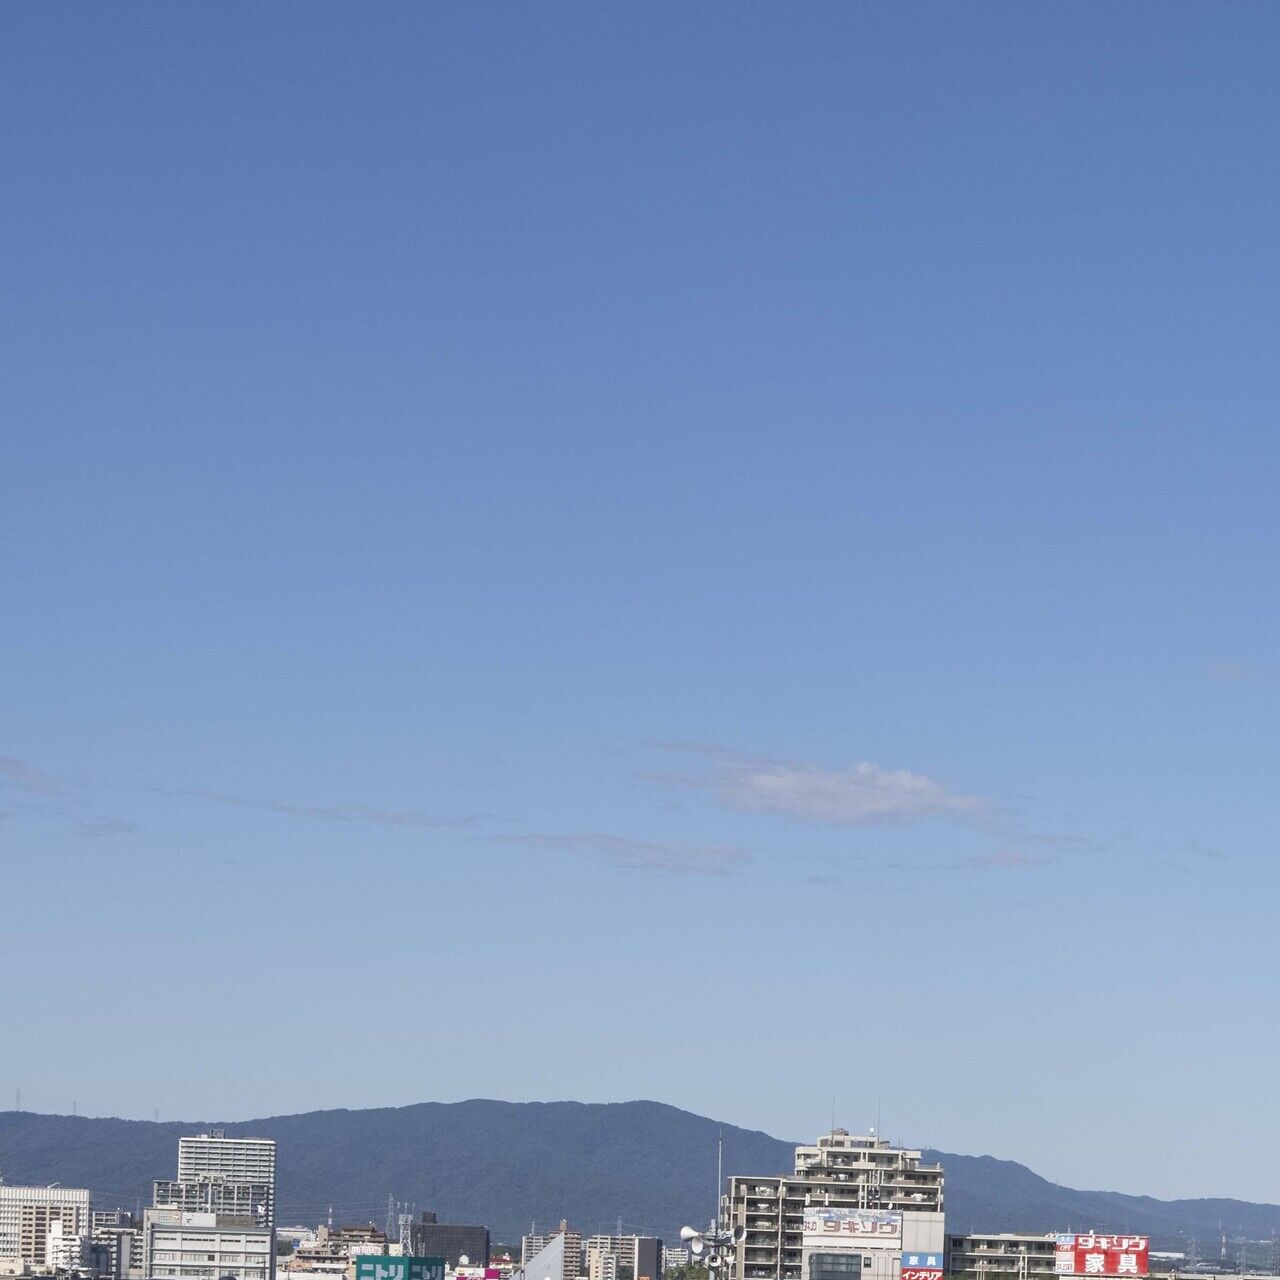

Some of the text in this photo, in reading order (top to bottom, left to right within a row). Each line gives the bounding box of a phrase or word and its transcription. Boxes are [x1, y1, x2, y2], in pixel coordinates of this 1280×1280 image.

[823, 1220, 898, 1235] タキソウ
[1077, 1235, 1146, 1251] タキソウ
[1084, 1253, 1138, 1274] 家具
[902, 1271, 942, 1280] インテリア
